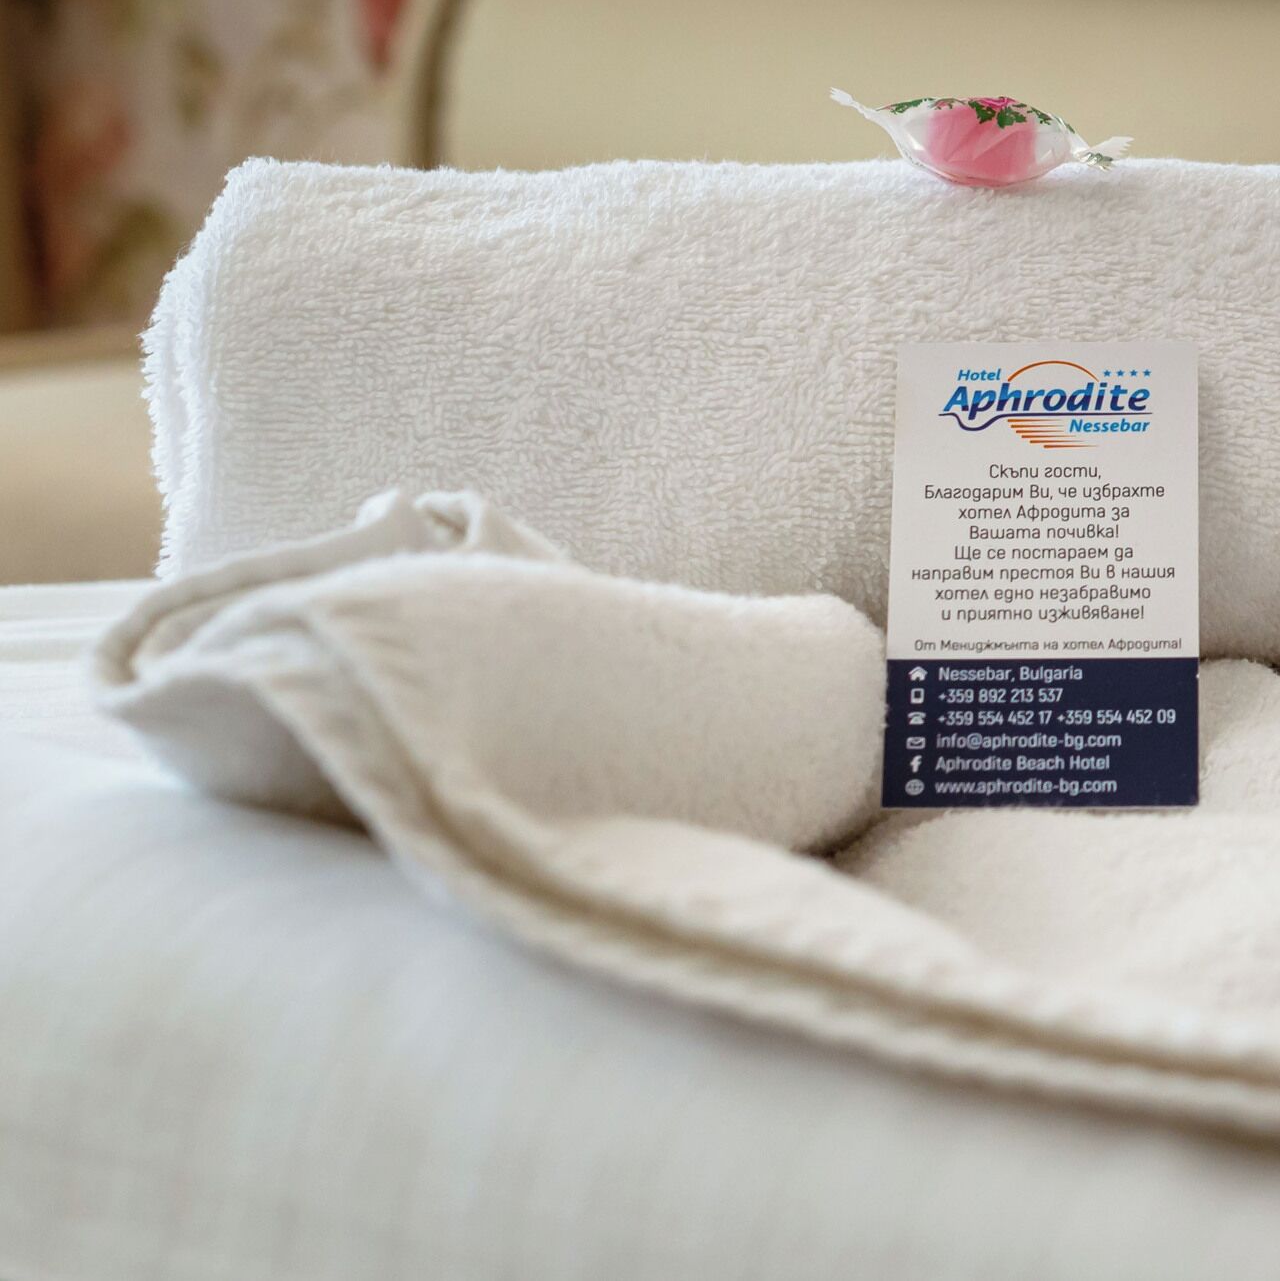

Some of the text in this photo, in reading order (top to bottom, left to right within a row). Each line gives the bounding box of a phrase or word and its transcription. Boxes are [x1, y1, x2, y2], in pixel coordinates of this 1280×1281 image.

[957, 369, 1002, 382] Hotel
[943, 382, 1151, 420] Aphrodite
[1069, 419, 1150, 433] Nessebar
[989, 464, 1102, 480] Скъпи гости,
[924, 483, 1165, 503] Благодарим Ви, че избрахте
[958, 505, 1130, 522] хотел Афродита за
[969, 523, 1119, 540] Вашата почивка!
[954, 545, 1134, 562] Ще се постараем да
[911, 564, 1175, 583] направим престоя Ви в нашия
[935, 585, 1151, 604] хотел едно незабравимо
[941, 604, 1144, 624] и приятно изживяване!
[914, 639, 936, 652] От
[1043, 641, 1059, 651] на
[1063, 639, 1104, 650] хотел
[938, 665, 1083, 683] Nessebar, Bulgaria
[938, 687, 1064, 704] +359 892 213 537
[938, 708, 1177, 726] +359 554 452 17 +359 554 452 09
[936, 732, 1122, 751] info@aphrodite-bg.com
[935, 754, 1110, 773] Aphrodite Beach Hotel
[935, 778, 1118, 797] www.aphrodite-bg.com
